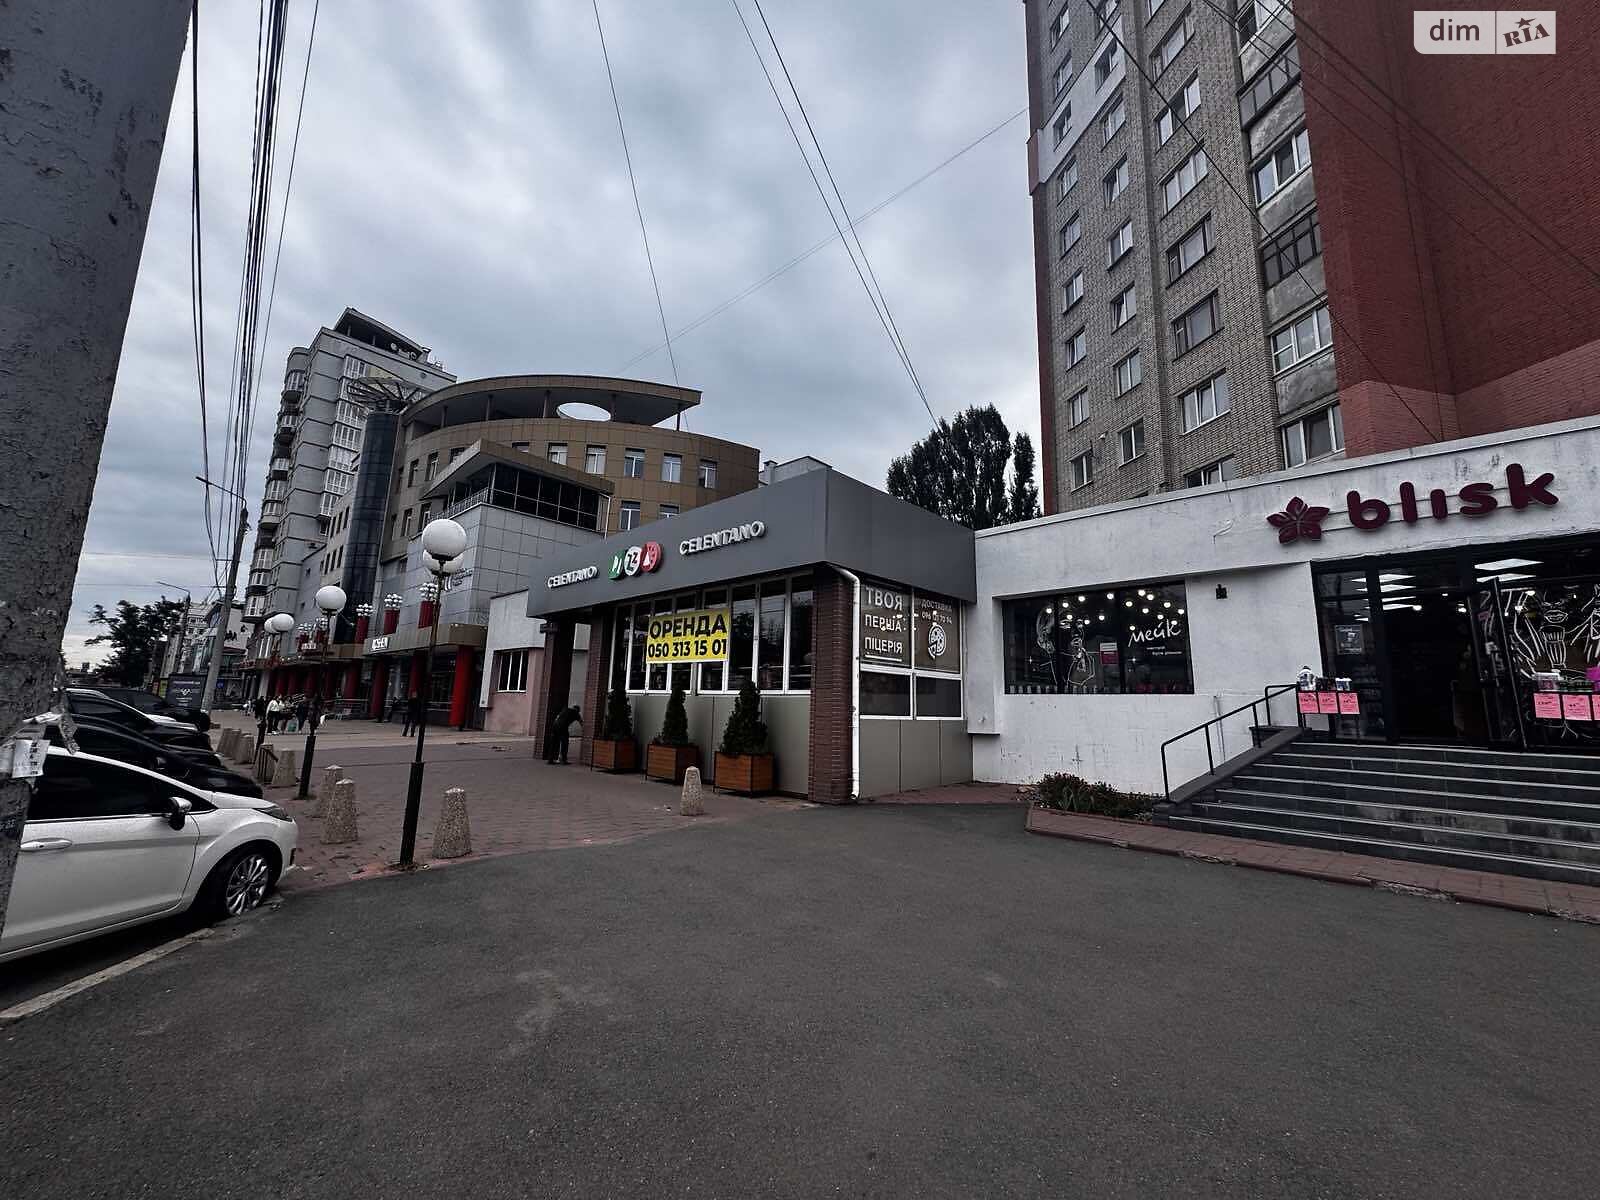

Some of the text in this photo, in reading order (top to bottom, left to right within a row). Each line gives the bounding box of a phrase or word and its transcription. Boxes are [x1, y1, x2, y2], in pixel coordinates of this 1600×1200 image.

[1346, 462, 1560, 531] blisk
[547, 565, 598, 589] CELENTANO
[679, 520, 766, 556] CELENTANO
[865, 587, 903, 611] ТВОЯ
[649, 613, 727, 639] ОРЕНДА
[865, 614, 903, 633] ПЕРША
[647, 637, 727, 658] 050 313 15 01
[864, 636, 903, 654] ПІЦЕРІЯ
